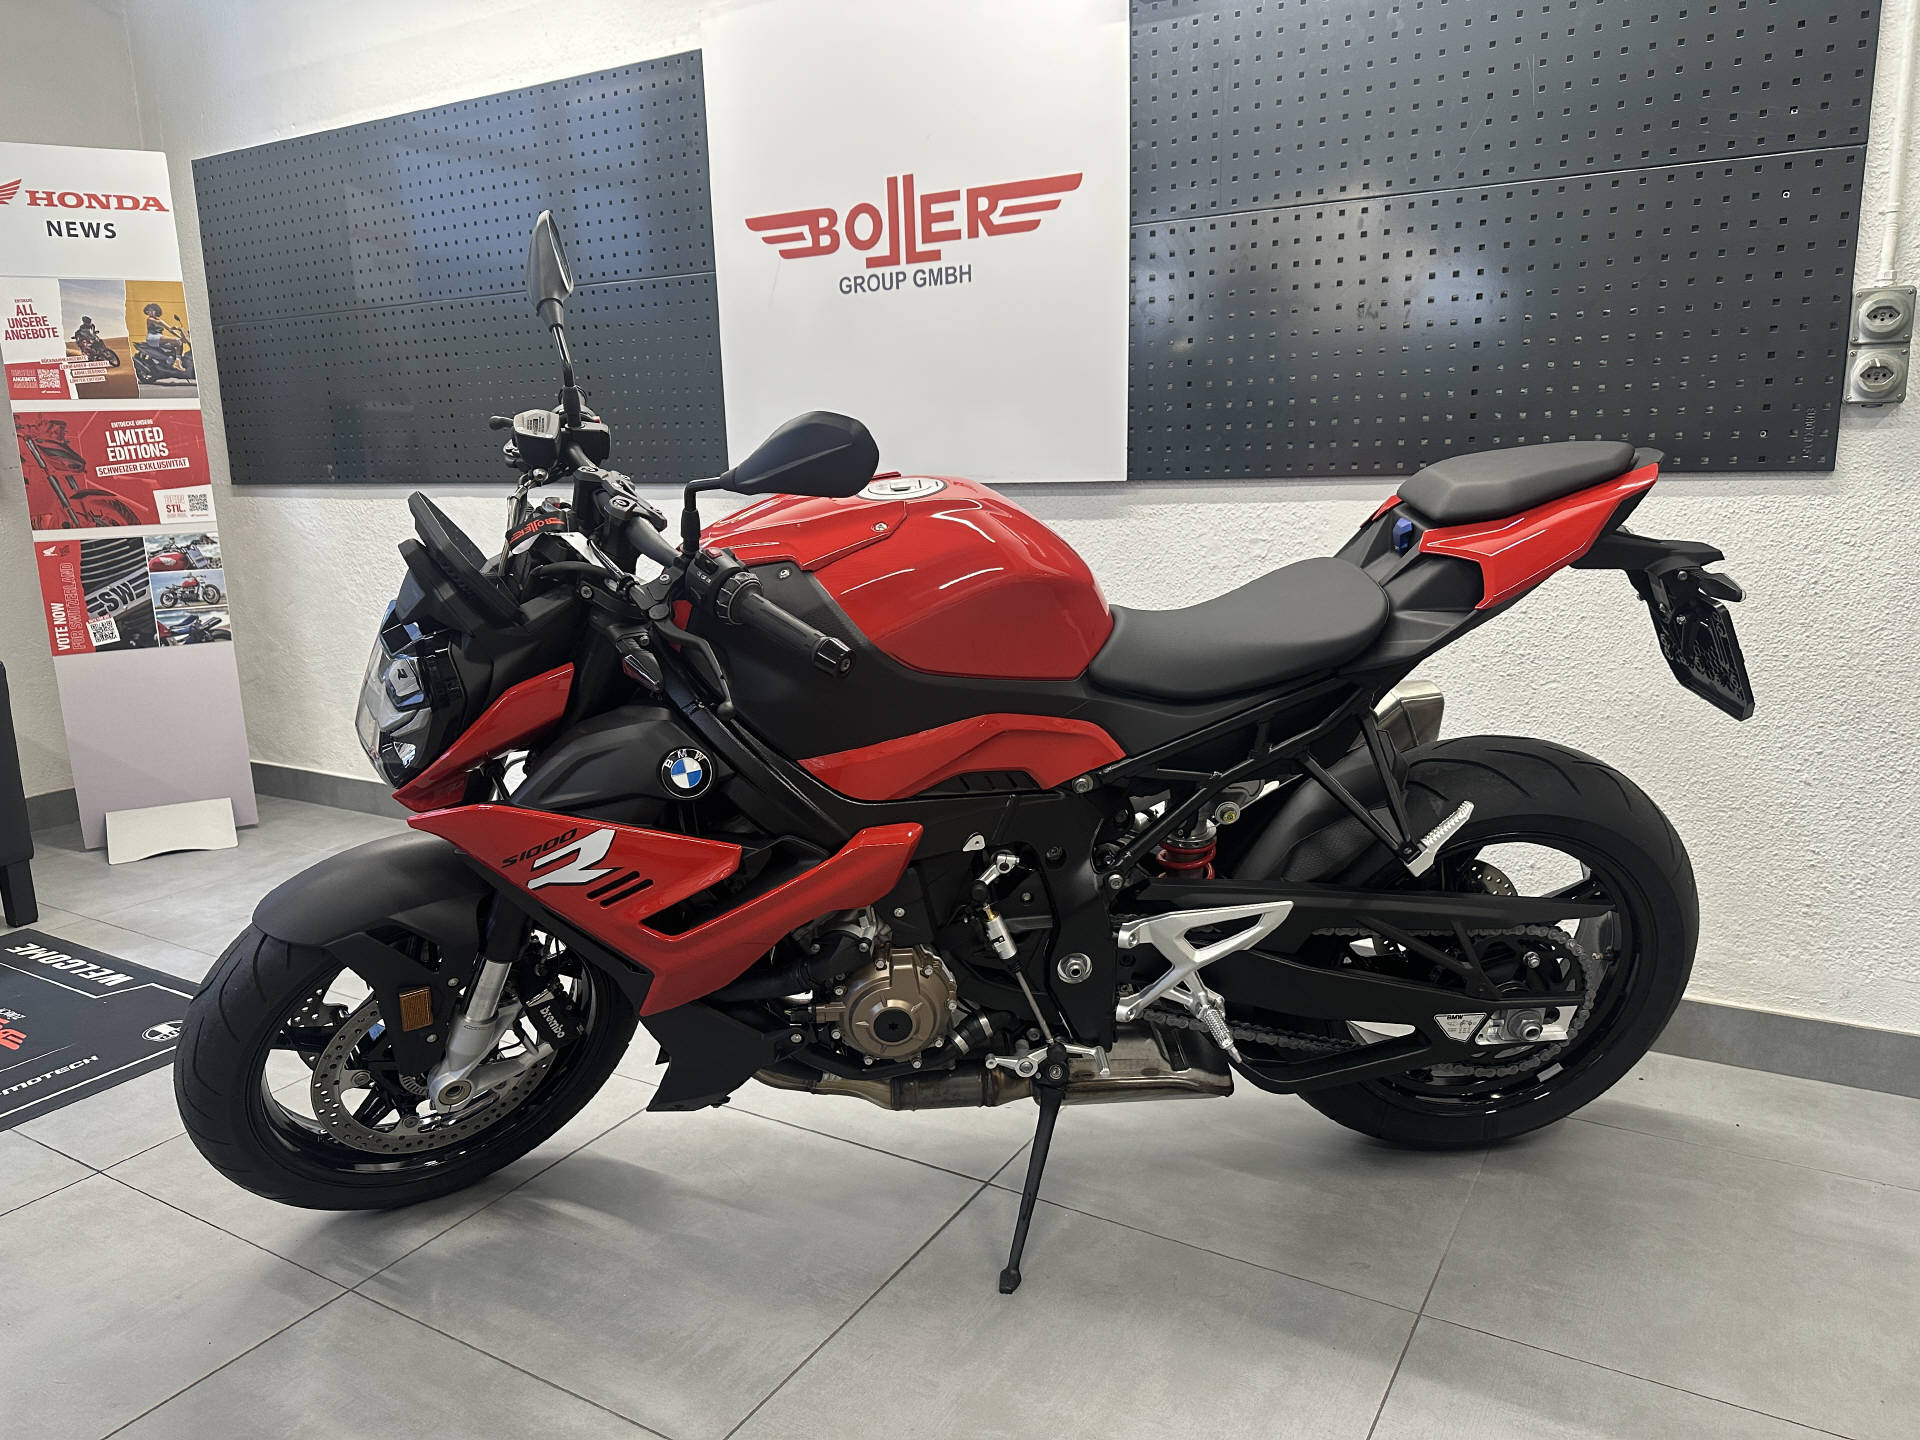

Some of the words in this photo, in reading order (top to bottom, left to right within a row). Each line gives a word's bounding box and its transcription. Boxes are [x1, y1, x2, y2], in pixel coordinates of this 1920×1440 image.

[25, 189, 170, 212] HONDA
[46, 219, 117, 239] NEWS
[745, 172, 1083, 269] BOLLER
[839, 271, 907, 295] GROUP
[912, 264, 973, 288] GMBH
[16, 304, 38, 316] ALL
[5, 327, 60, 341] ANGEBOTE
[7, 316, 49, 329] UNSERE
[105, 426, 164, 447] LIMITED
[106, 442, 169, 462] EDITIONS
[97, 464, 139, 476] SCHWEIZER
[50, 602, 67, 625] NOW
[54, 625, 71, 651] VOTE
[663, 749, 706, 769] BMW
[501, 827, 578, 869] S1000
[3, 942, 135, 987] WELCOME
[540, 1005, 566, 1039] brembo
[0, 1055, 99, 1096] MOTECH
